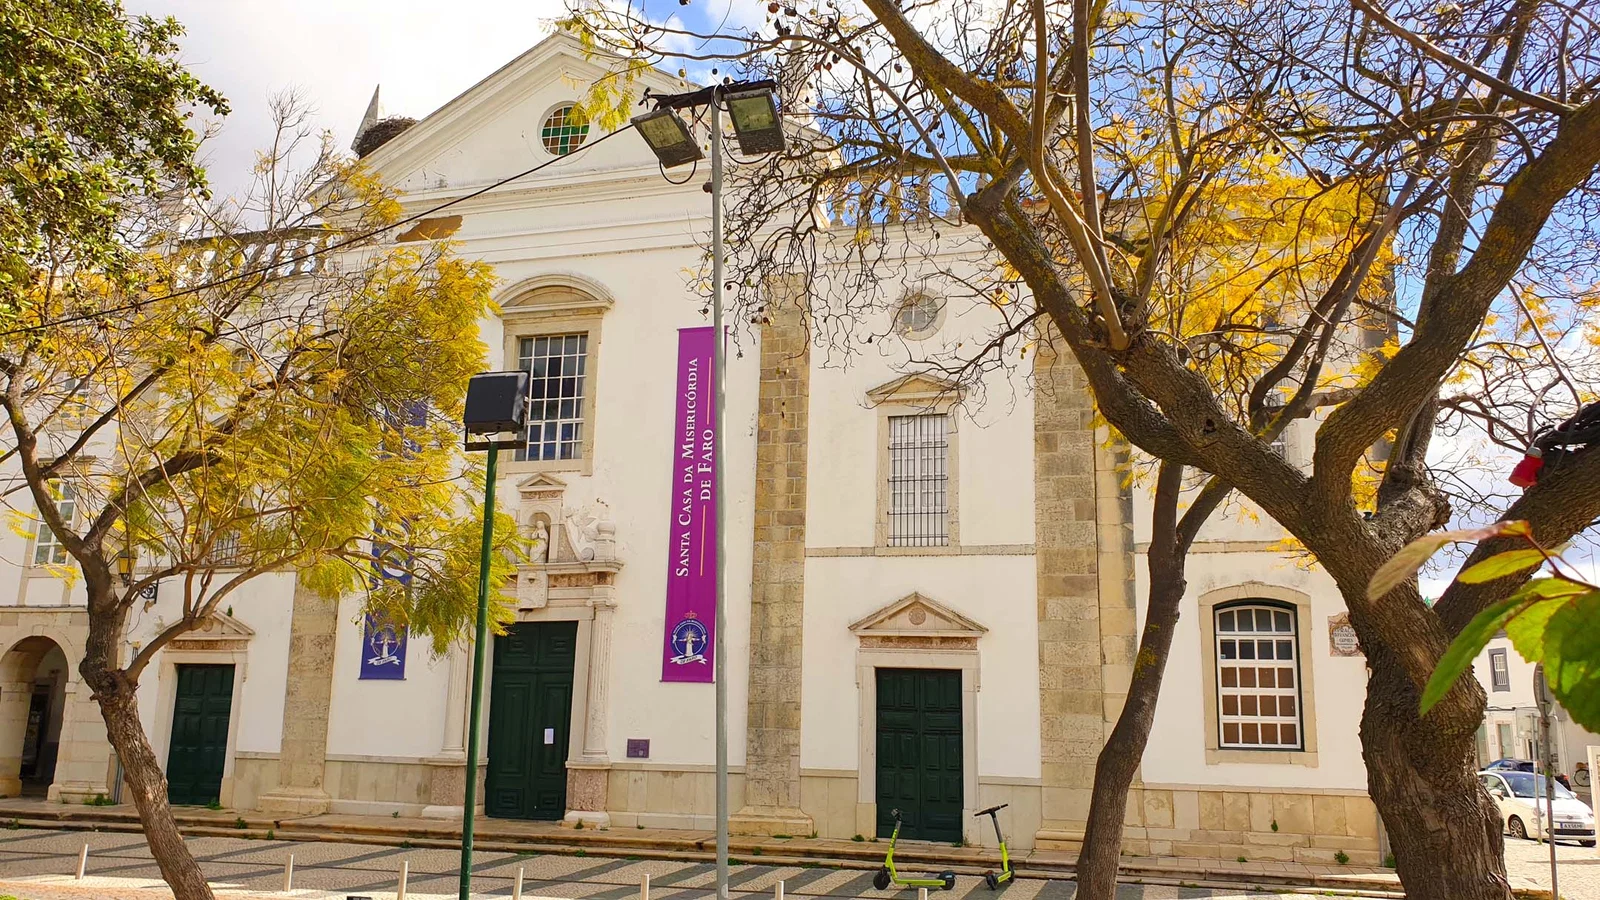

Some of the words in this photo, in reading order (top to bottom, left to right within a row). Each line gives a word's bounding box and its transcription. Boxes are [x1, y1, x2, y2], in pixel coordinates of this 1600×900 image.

[682, 357, 698, 459] MISERICÓRDIA
[697, 429, 714, 474] FARO
[684, 464, 694, 483] DA
[700, 479, 712, 501] DE
[678, 488, 693, 526] CASA
[676, 531, 690, 577] SANTA
